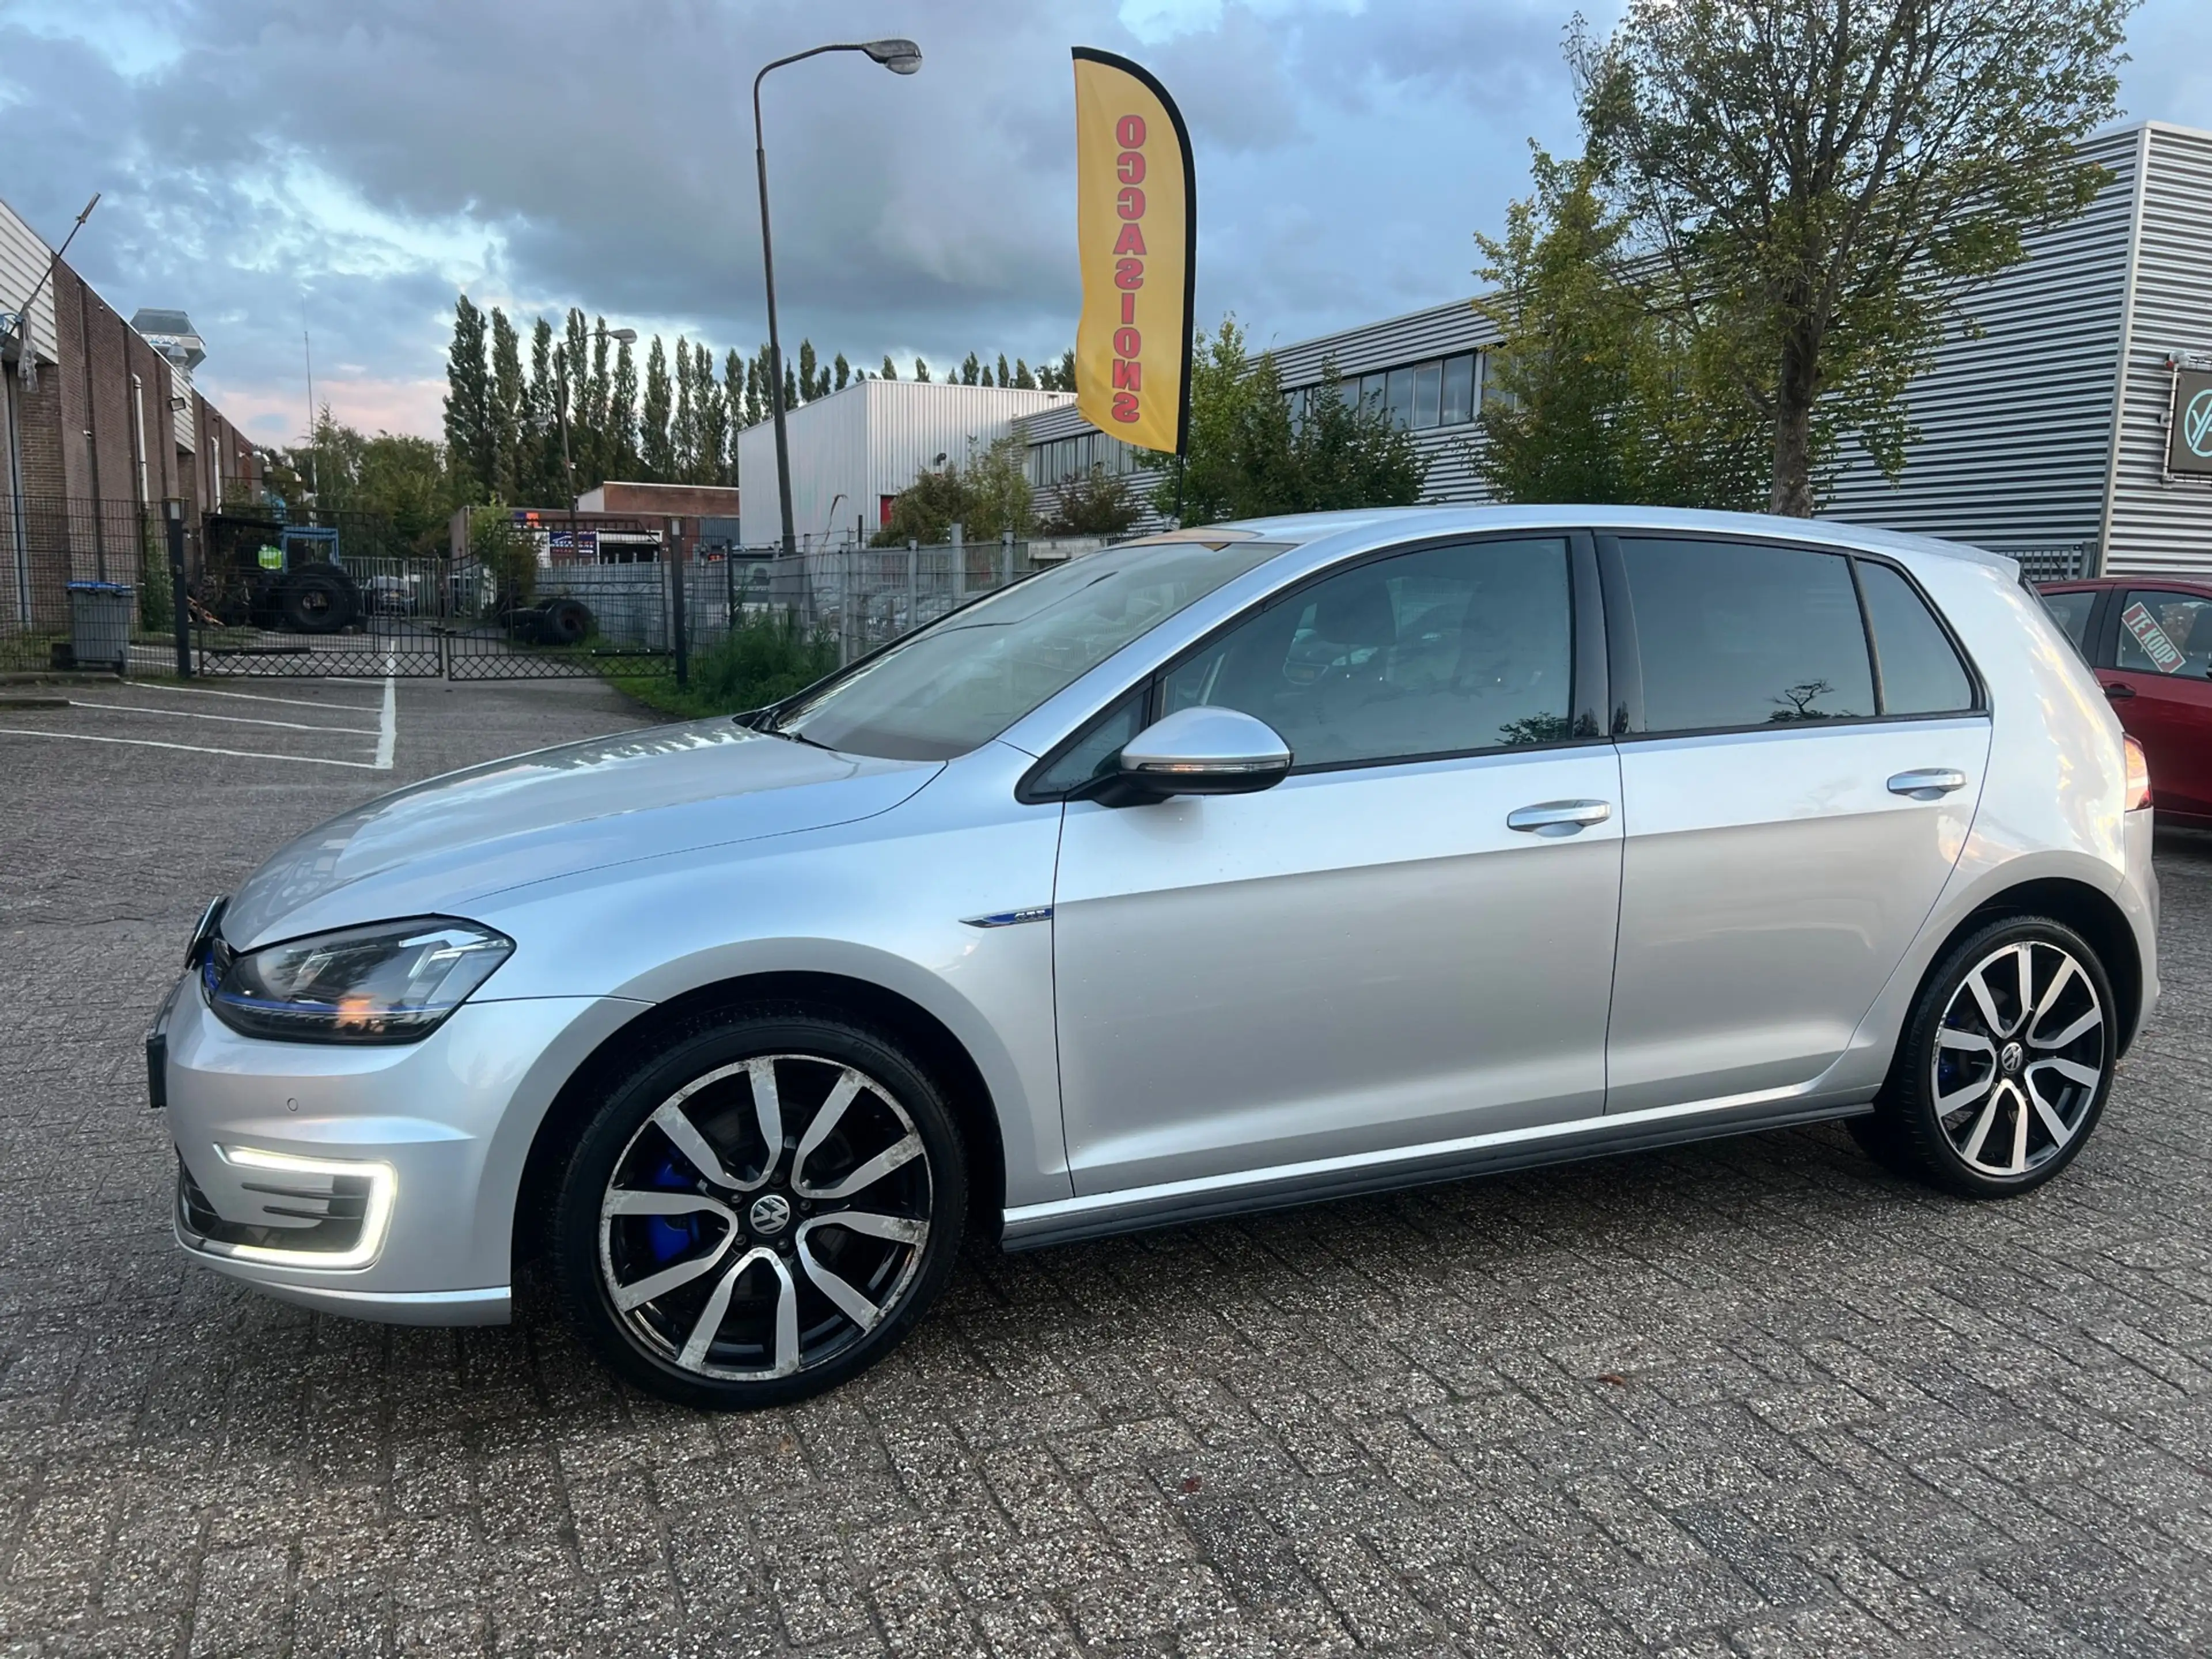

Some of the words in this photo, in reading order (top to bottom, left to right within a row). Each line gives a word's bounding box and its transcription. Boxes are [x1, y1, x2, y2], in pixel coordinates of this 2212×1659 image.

[2128, 611, 2152, 634] TE
[2140, 628, 2177, 664] KOOP
[750, 1195, 790, 1234] VW
